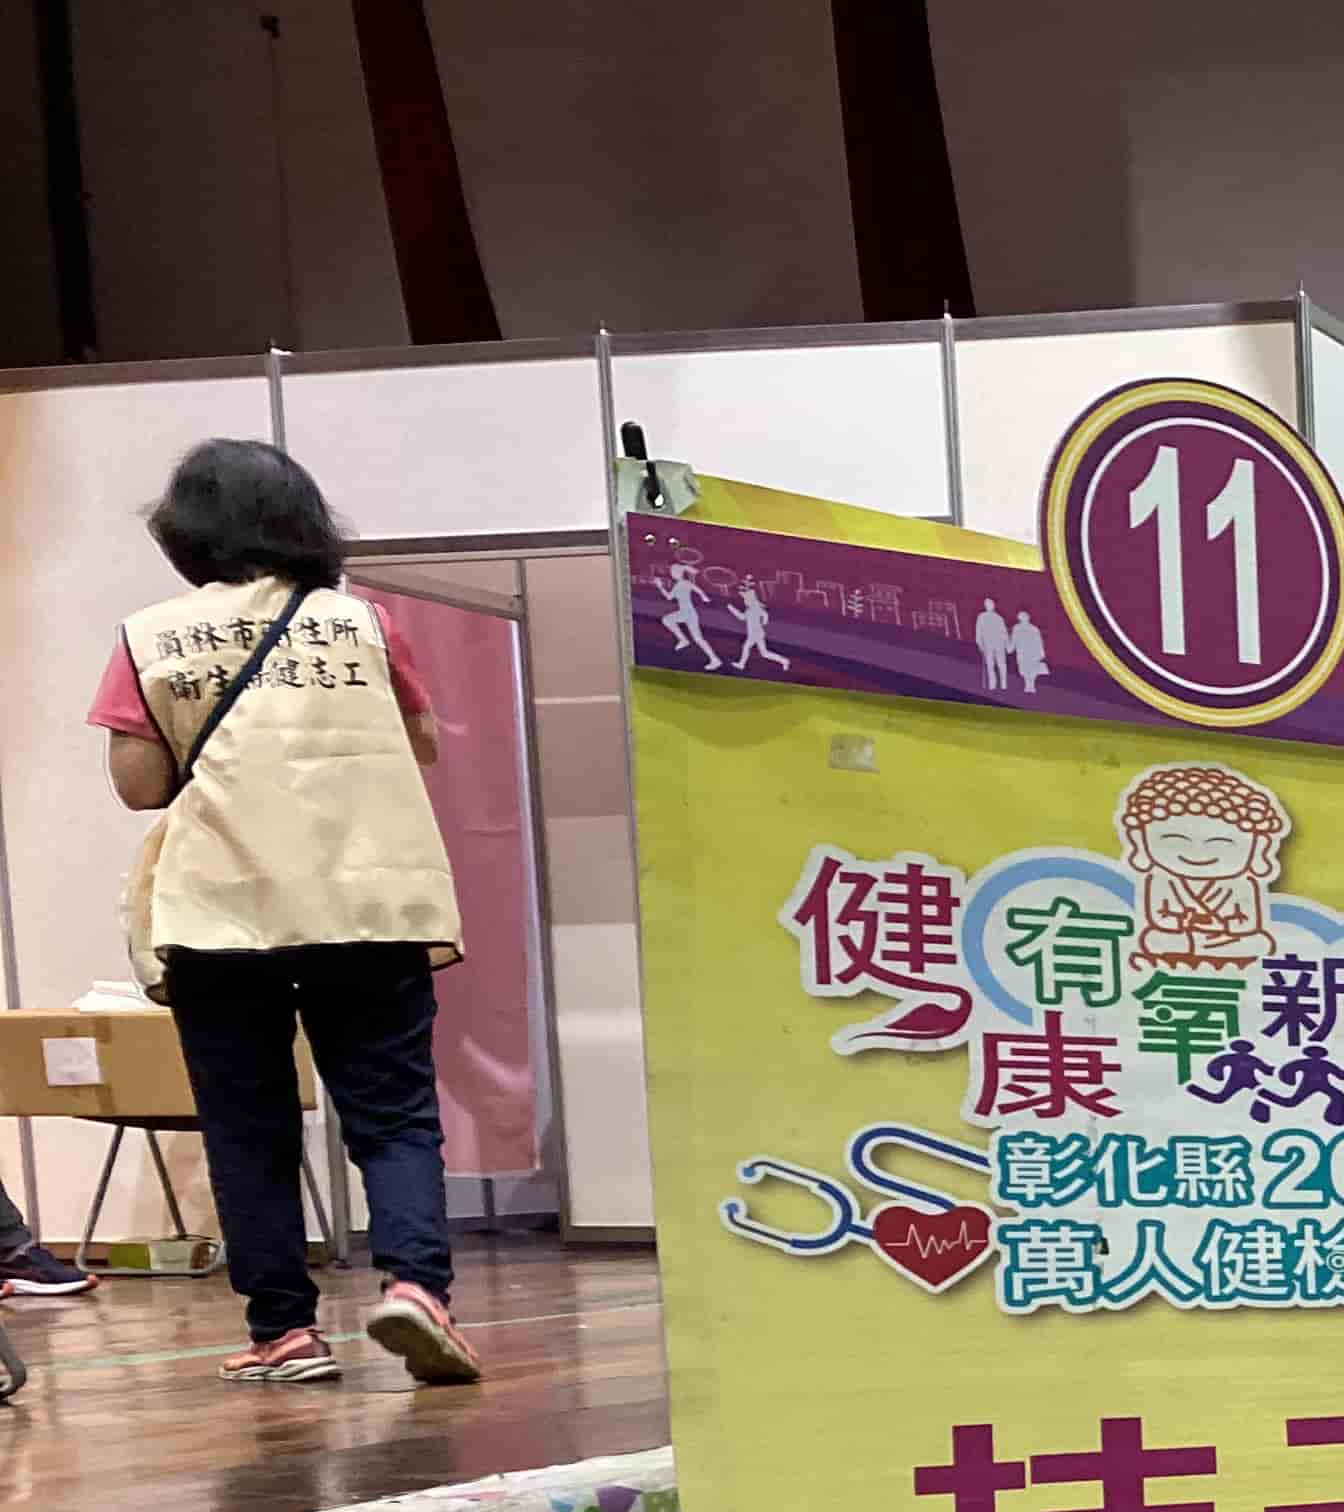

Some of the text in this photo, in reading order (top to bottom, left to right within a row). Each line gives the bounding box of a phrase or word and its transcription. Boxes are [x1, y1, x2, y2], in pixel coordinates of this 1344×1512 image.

[1128, 444, 1262, 667] 11
[156, 616, 359, 659] 員林市生所
[167, 656, 368, 701] 衛生健志工
